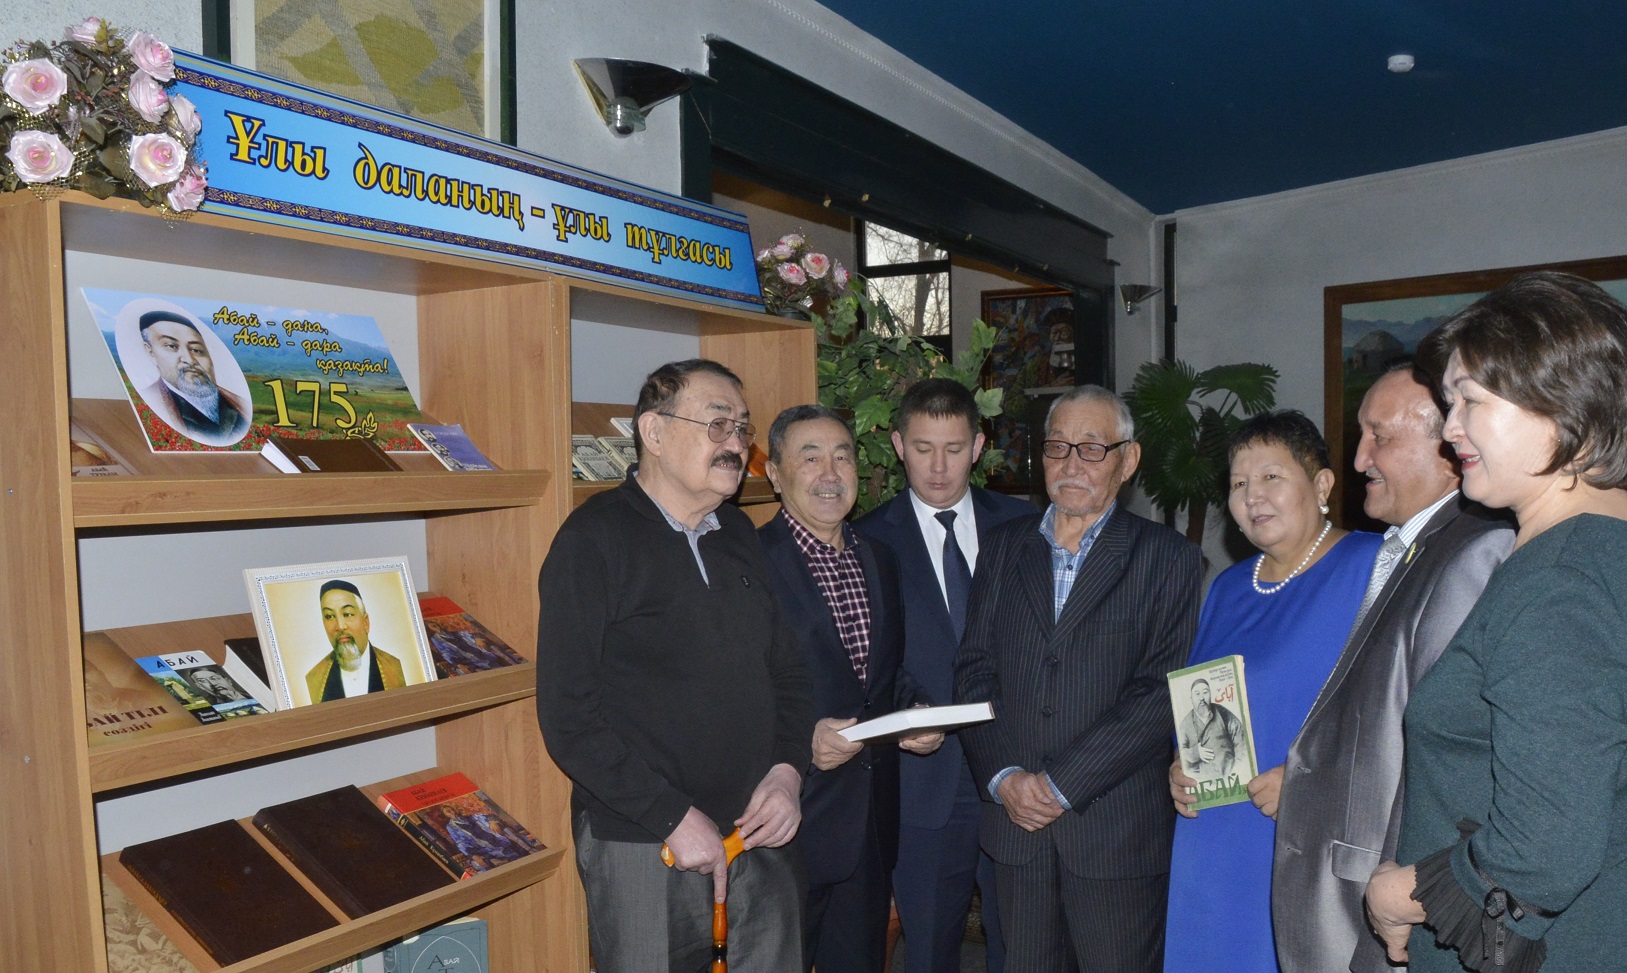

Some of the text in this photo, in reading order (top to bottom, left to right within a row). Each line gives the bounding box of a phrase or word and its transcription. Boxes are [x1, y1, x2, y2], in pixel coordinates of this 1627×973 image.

[224, 110, 330, 180] Ұлы
[353, 142, 525, 231] даланың
[551, 203, 611, 243] ұлы
[213, 306, 260, 327] Абай
[282, 319, 329, 337] дана,
[233, 327, 281, 349] Абай
[301, 339, 343, 356] дара
[262, 378, 358, 430] 175
[156, 655, 199, 669] АБАЙ
